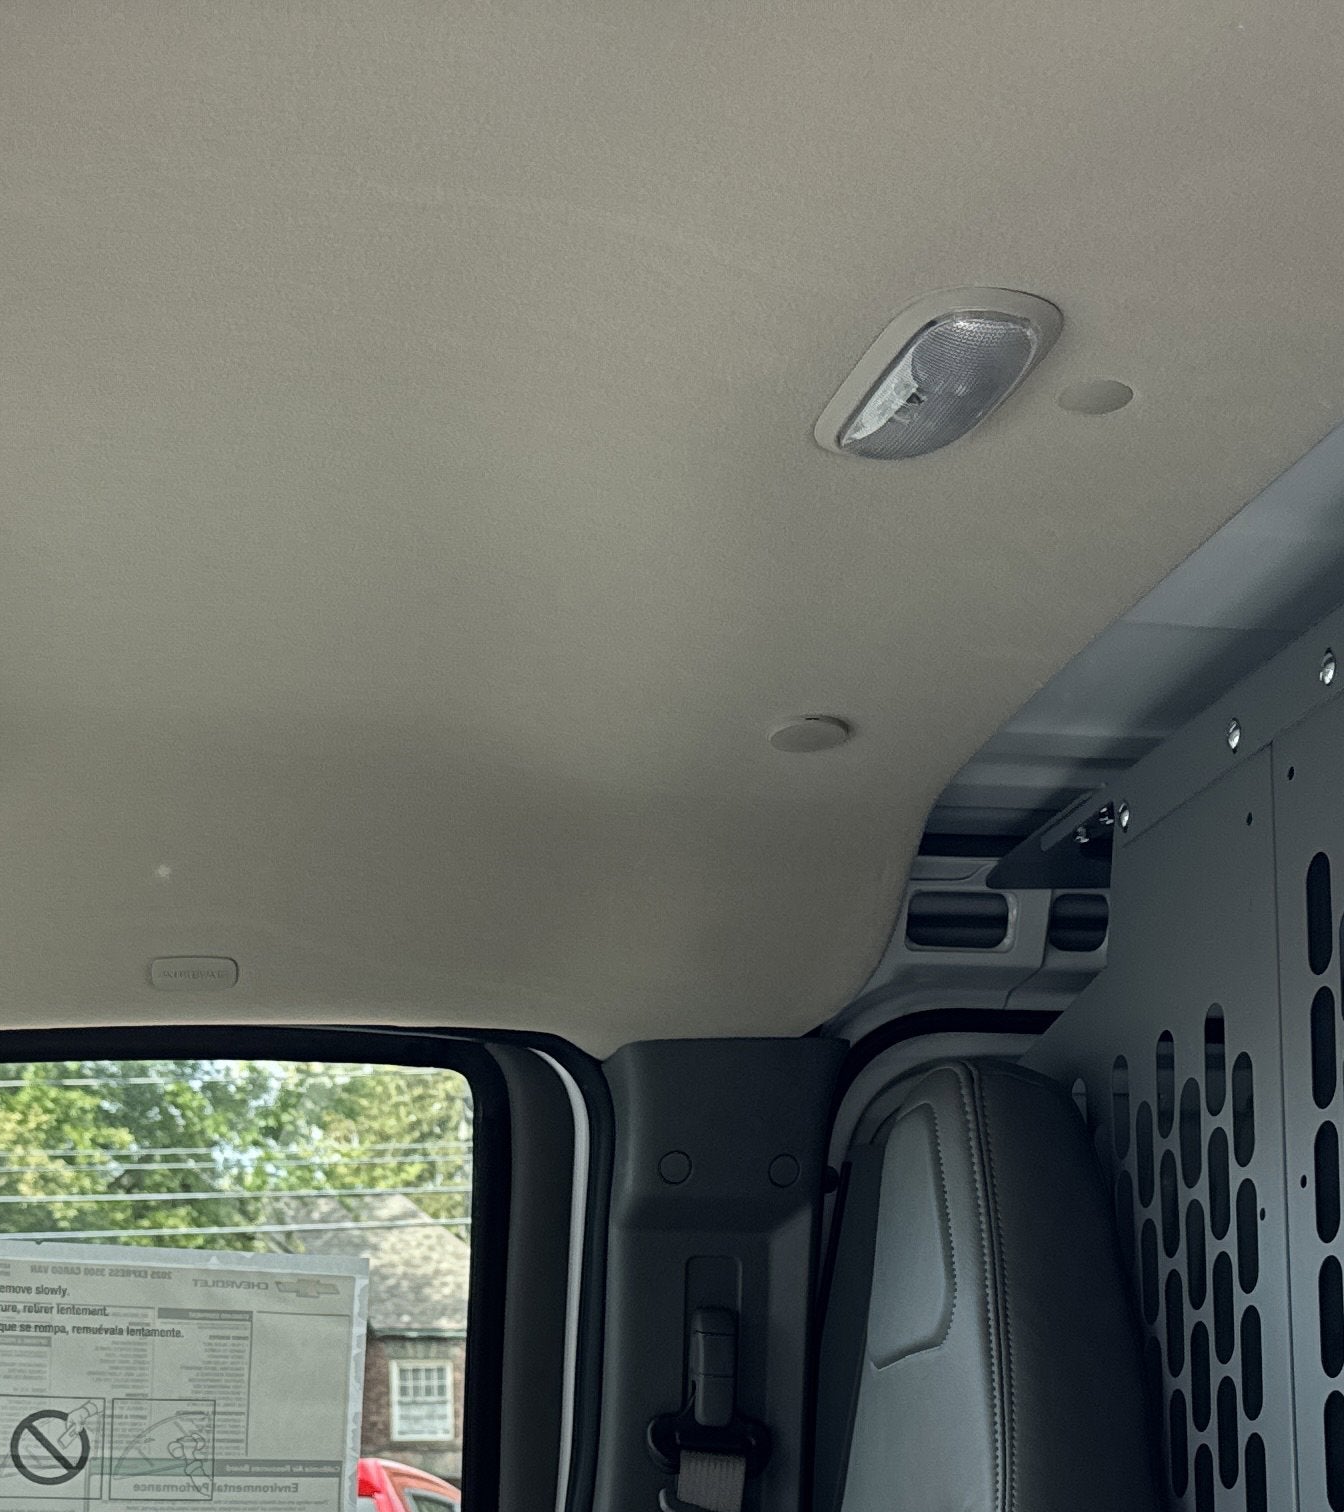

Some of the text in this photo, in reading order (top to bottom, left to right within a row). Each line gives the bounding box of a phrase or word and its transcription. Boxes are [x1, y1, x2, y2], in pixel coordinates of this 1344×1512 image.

[36, 1284, 70, 1298] slowly.
[23, 1304, 54, 1314] retirer
[19, 1323, 32, 1333] se
[34, 1324, 69, 1336] rompa,
[126, 1326, 185, 1338] lentamente.
